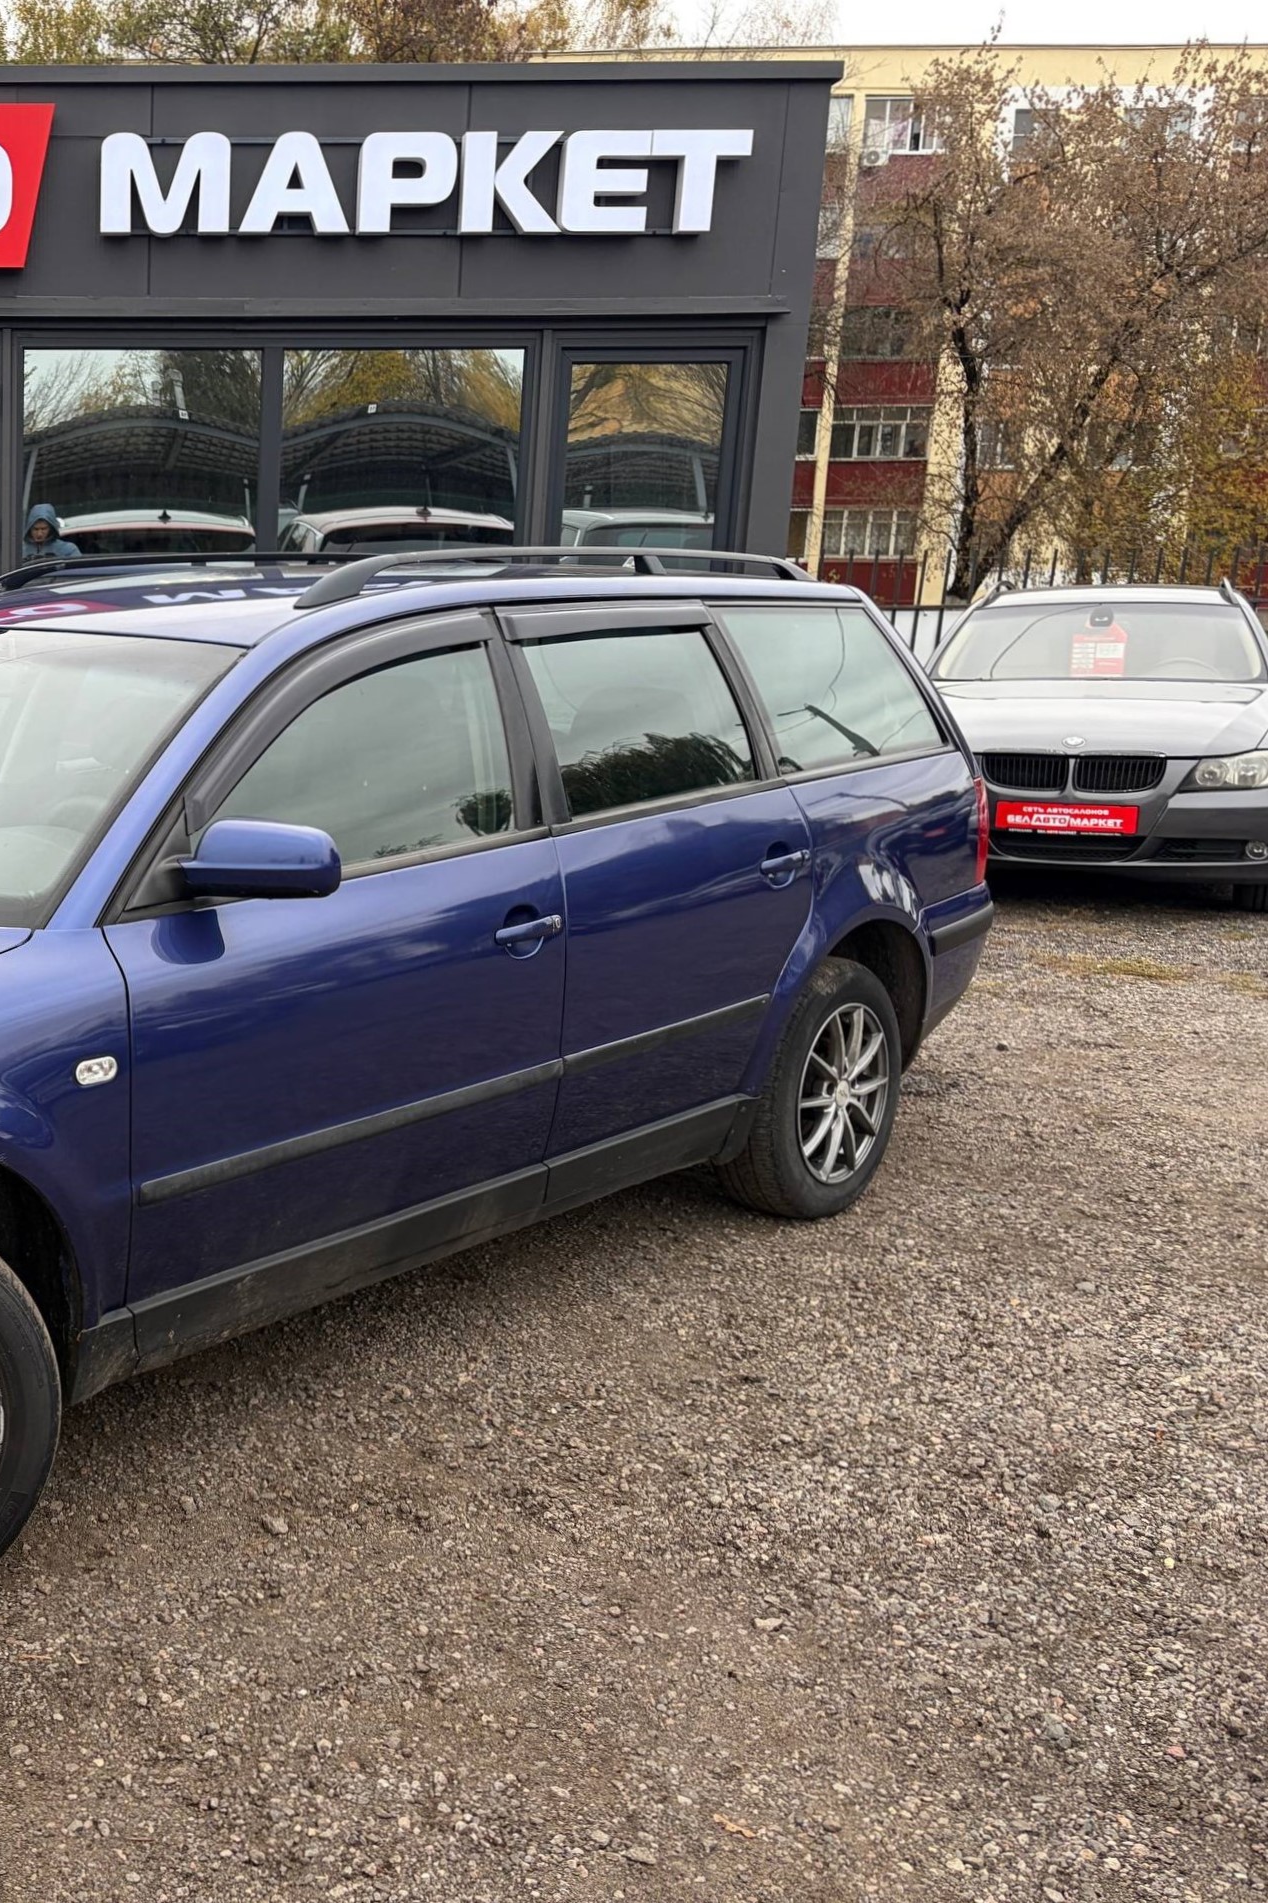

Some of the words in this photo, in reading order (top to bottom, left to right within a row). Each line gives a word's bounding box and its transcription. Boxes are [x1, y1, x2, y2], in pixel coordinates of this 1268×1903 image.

[100, 128, 754, 237] МАРКЕТ
[1033, 816, 1068, 825] АВТО
[1070, 818, 1123, 828] МАРКЕТ
